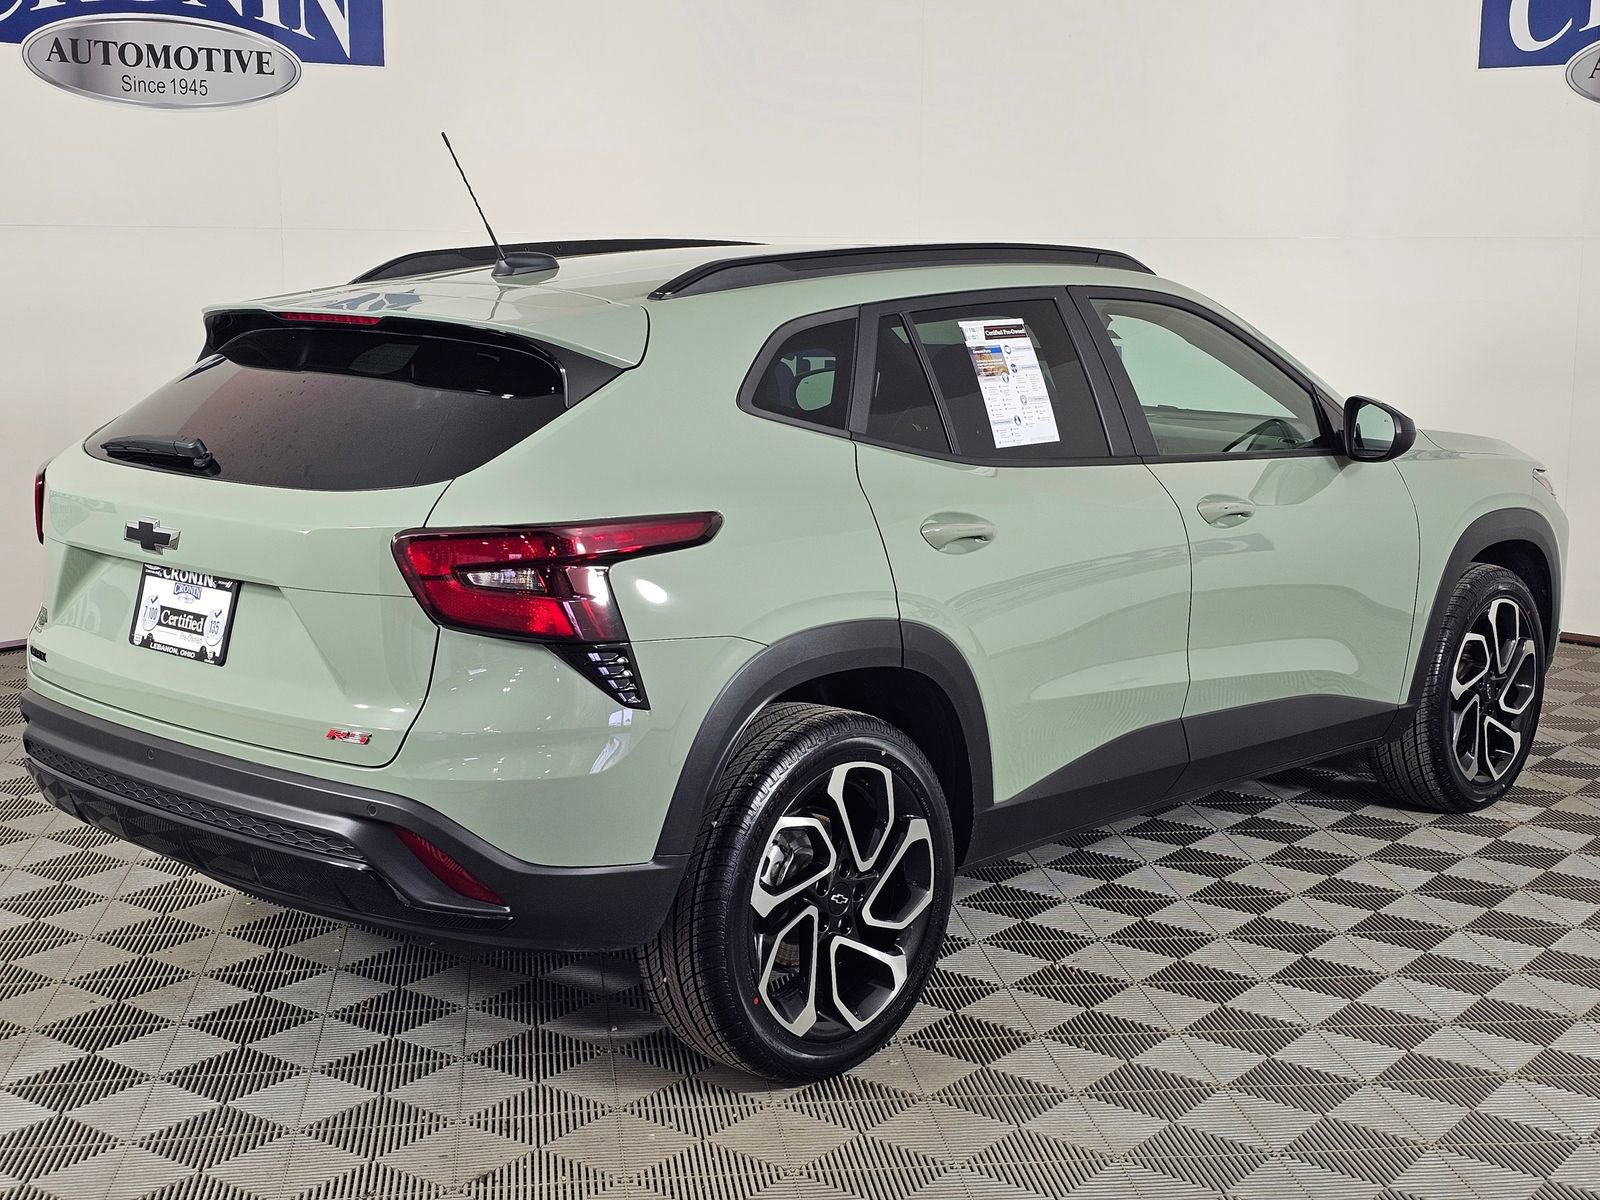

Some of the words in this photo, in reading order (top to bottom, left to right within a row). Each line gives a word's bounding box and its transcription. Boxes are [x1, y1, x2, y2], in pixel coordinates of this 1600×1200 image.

[46, 37, 276, 76] AUTOMOTIVE
[121, 74, 166, 95] Since
[169, 78, 209, 97] 1945
[163, 568, 214, 588] CRONIN
[174, 583, 202, 600] CRONIN
[160, 609, 204, 633] Certified
[150, 641, 179, 656] LEBANON,
[179, 650, 196, 659] OHIO
[326, 729, 373, 745] RS
